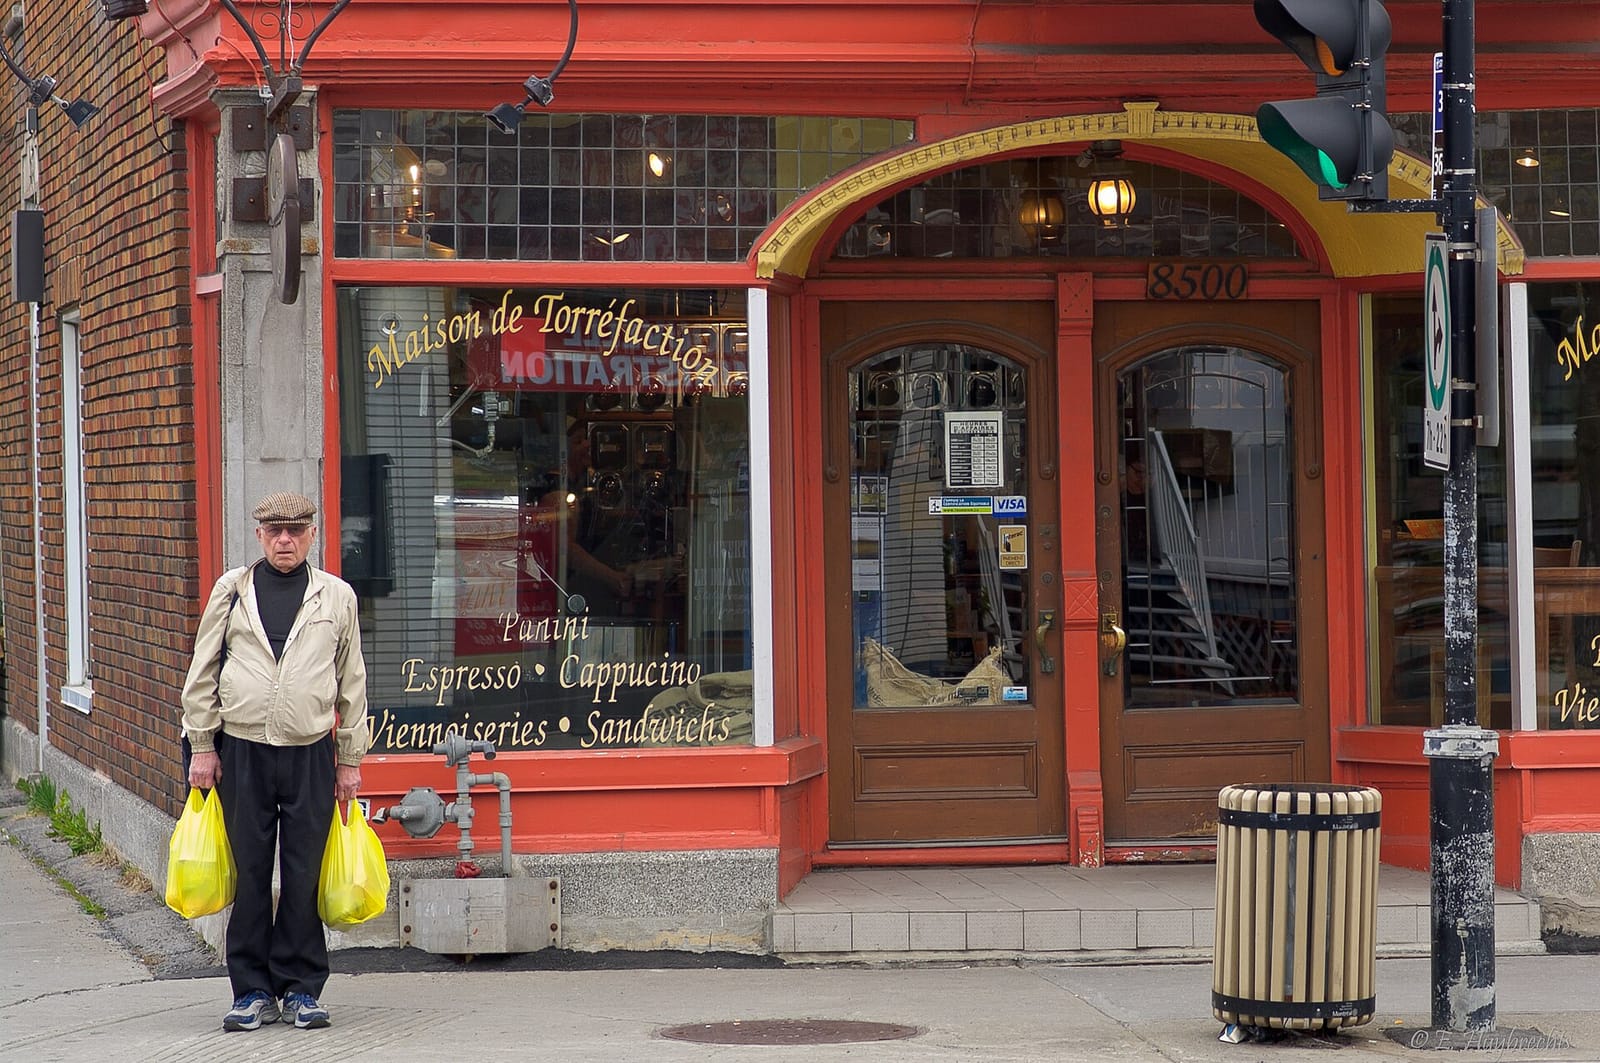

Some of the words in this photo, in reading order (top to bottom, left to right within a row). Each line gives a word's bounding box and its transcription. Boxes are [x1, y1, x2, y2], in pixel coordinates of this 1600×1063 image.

[1149, 264, 1247, 299] 8500
[367, 308, 484, 388] Maison
[491, 289, 523, 335] de
[534, 292, 720, 387] Torréfaction
[997, 499, 1025, 510] VISA
[498, 606, 590, 643] Panini
[401, 657, 521, 707] Espresso
[559, 651, 702, 704] Cappucino
[579, 703, 731, 749] Sandwichs
